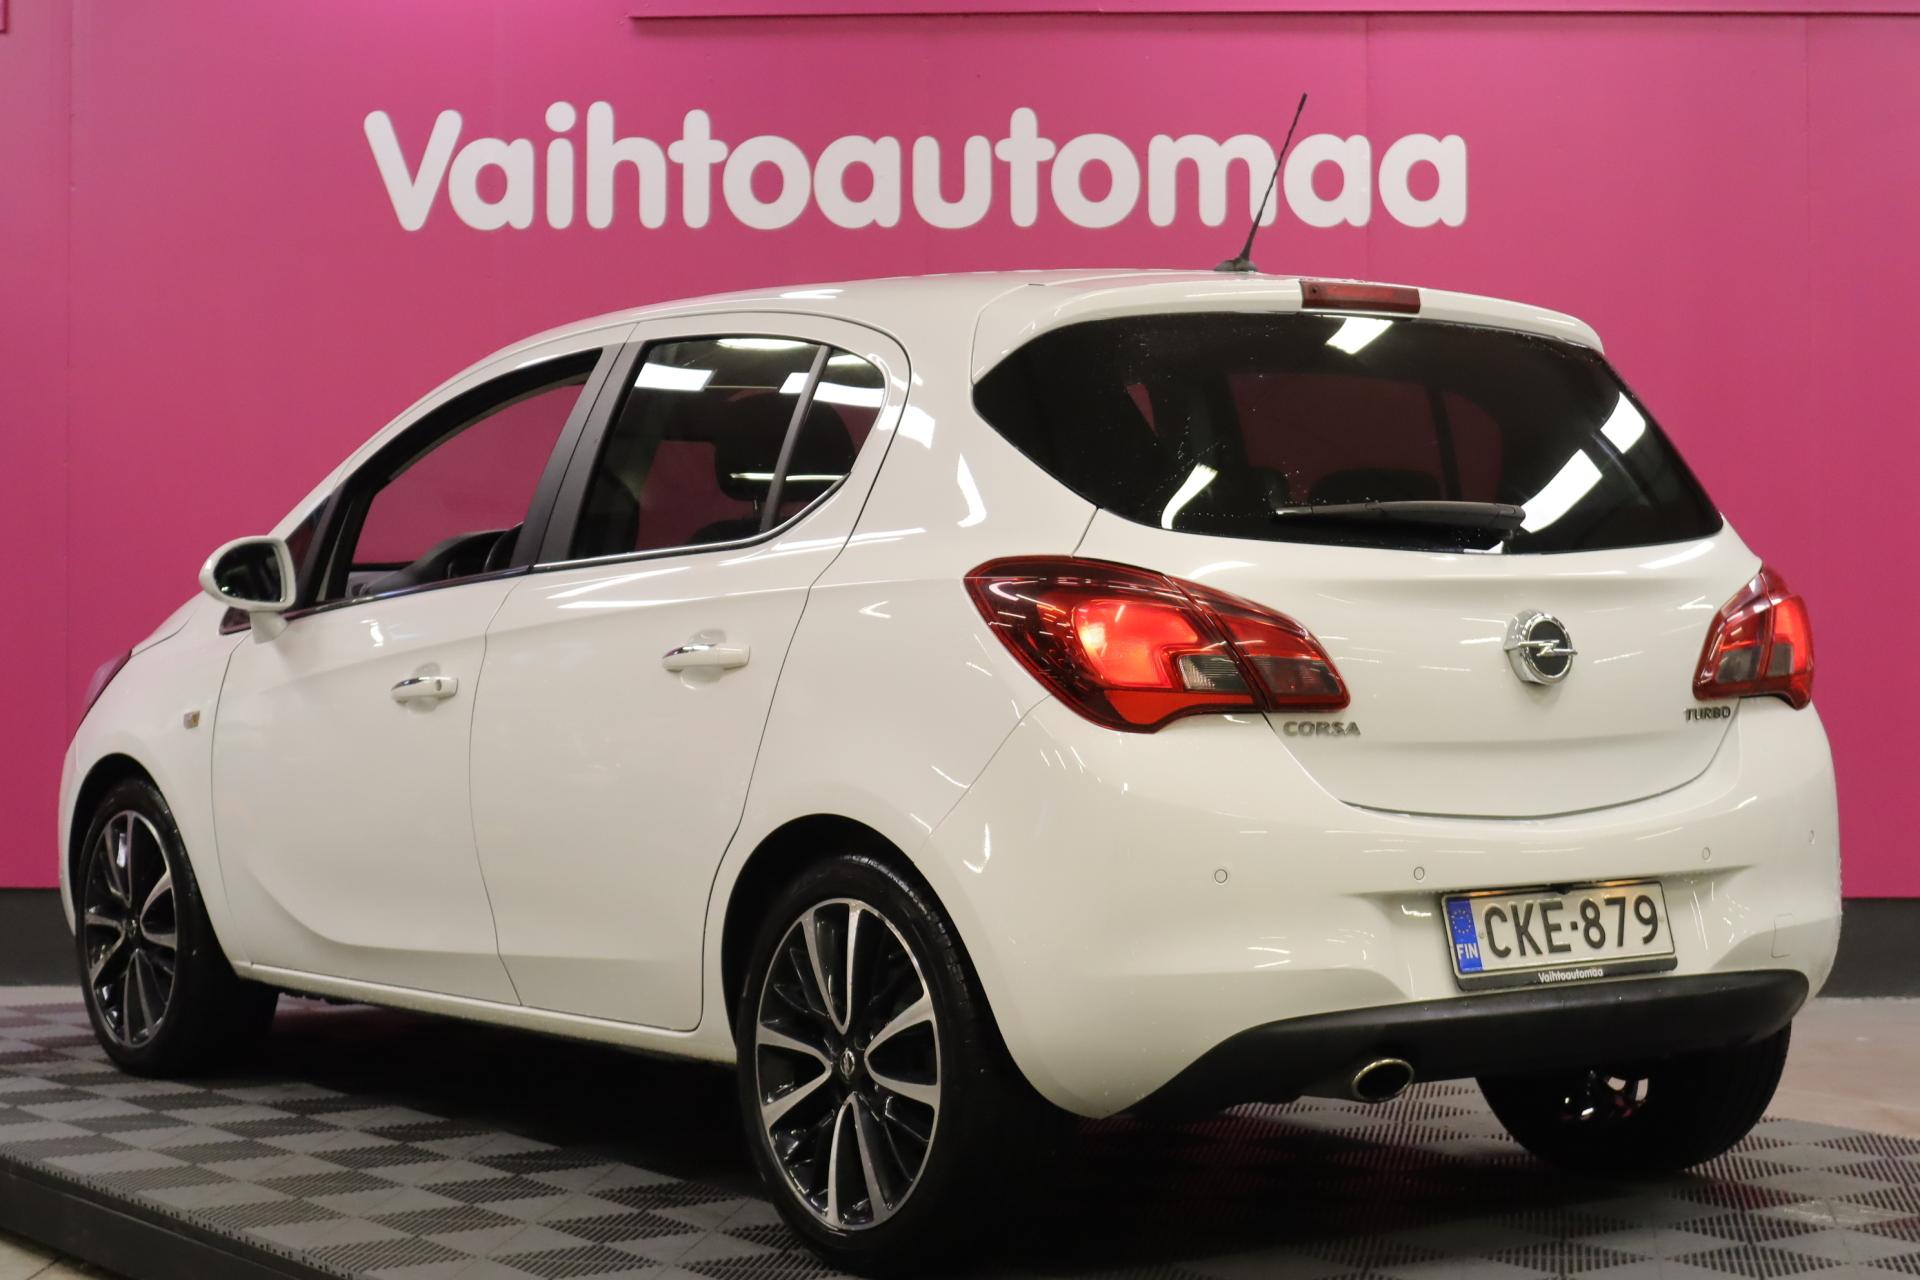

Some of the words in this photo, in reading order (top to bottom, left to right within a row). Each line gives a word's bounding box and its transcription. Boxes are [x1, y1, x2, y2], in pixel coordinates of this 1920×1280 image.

[364, 101, 1467, 230] Vaihtoautomaa
[1685, 706, 1731, 721] TURBO
[1283, 721, 1361, 737] CORSA
[1484, 895, 1659, 958] CKE-879
[1456, 943, 1479, 960] FIN
[1538, 967, 1604, 983] Vaihtoautomaa
